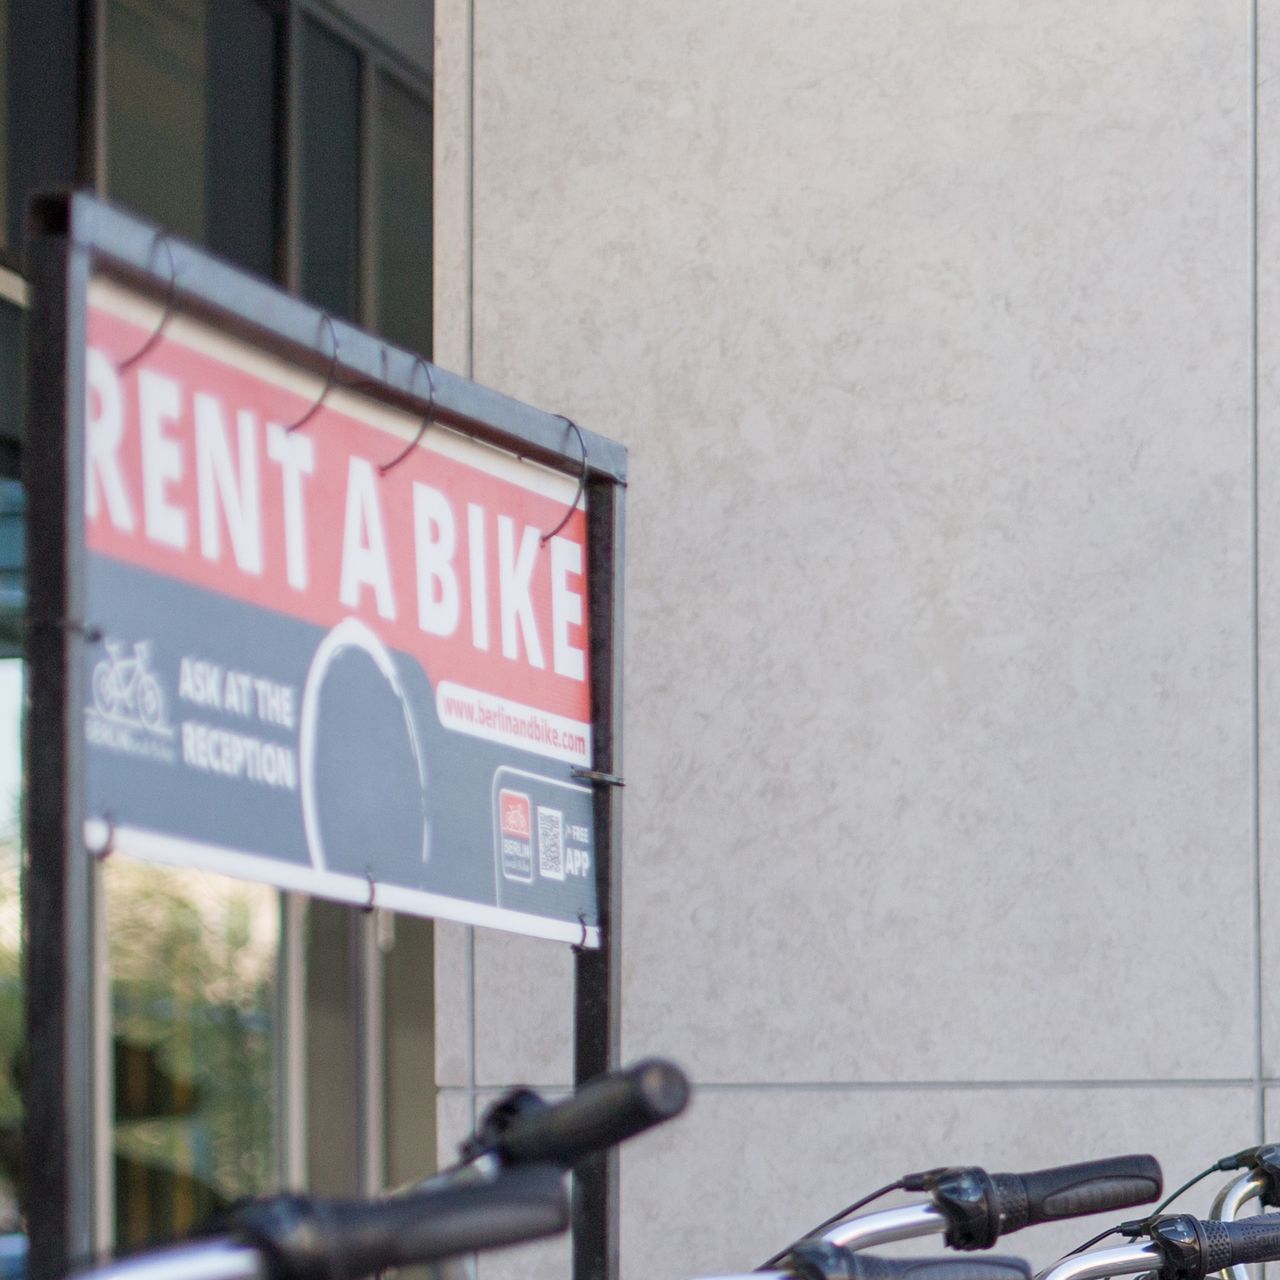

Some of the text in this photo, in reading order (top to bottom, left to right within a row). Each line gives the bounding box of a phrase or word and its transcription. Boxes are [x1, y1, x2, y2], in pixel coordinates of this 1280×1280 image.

[86, 349, 586, 683] RENT A BIKE
[178, 656, 295, 730] ASK AT THE
[443, 696, 586, 755] www.berlinandbike.com
[181, 720, 296, 790] RECEPTION
[565, 847, 590, 877] APP
